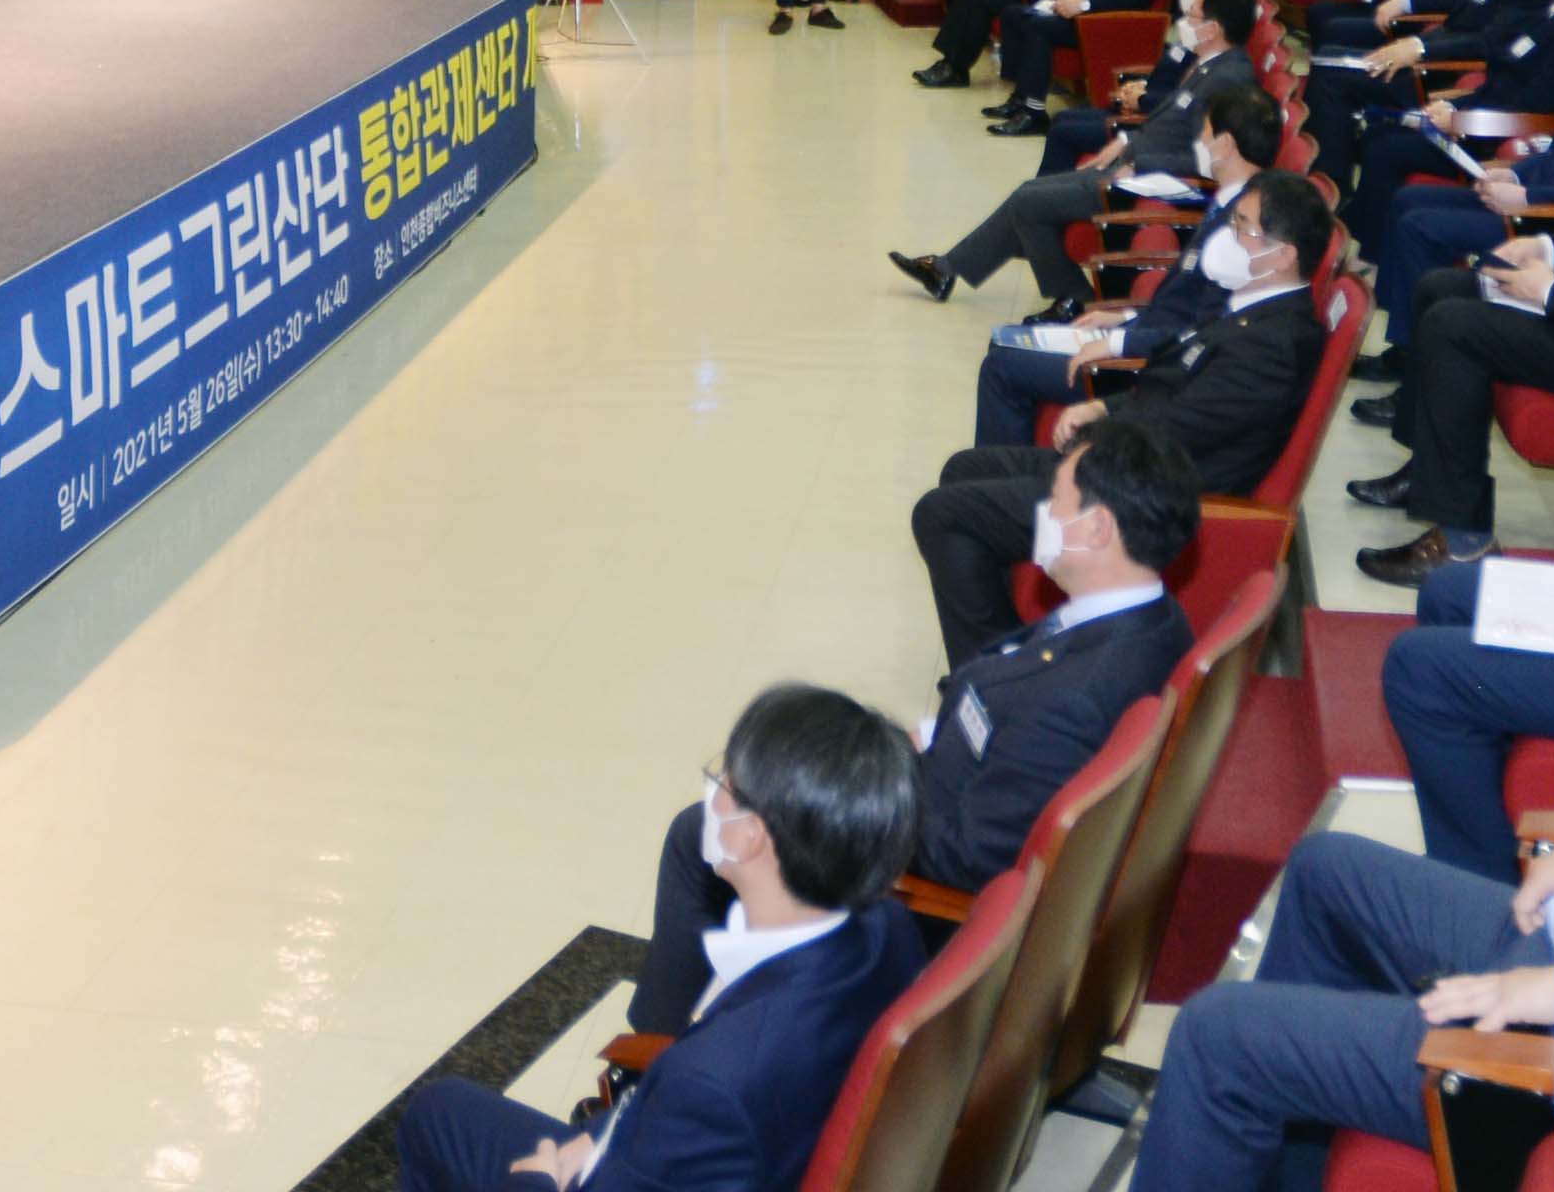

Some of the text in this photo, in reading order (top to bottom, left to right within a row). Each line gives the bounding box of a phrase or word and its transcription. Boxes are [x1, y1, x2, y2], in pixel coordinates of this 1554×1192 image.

[358, 17, 520, 221] 통합관제센터
[374, 239, 394, 280] 장소
[57, 463, 94, 532] 일시
[112, 404, 174, 486] 2021년
[177, 383, 203, 436] 5월
[206, 340, 262, 413] 26일(수)
[265, 311, 302, 365] 13:30
[315, 274, 349, 324] 14:40
